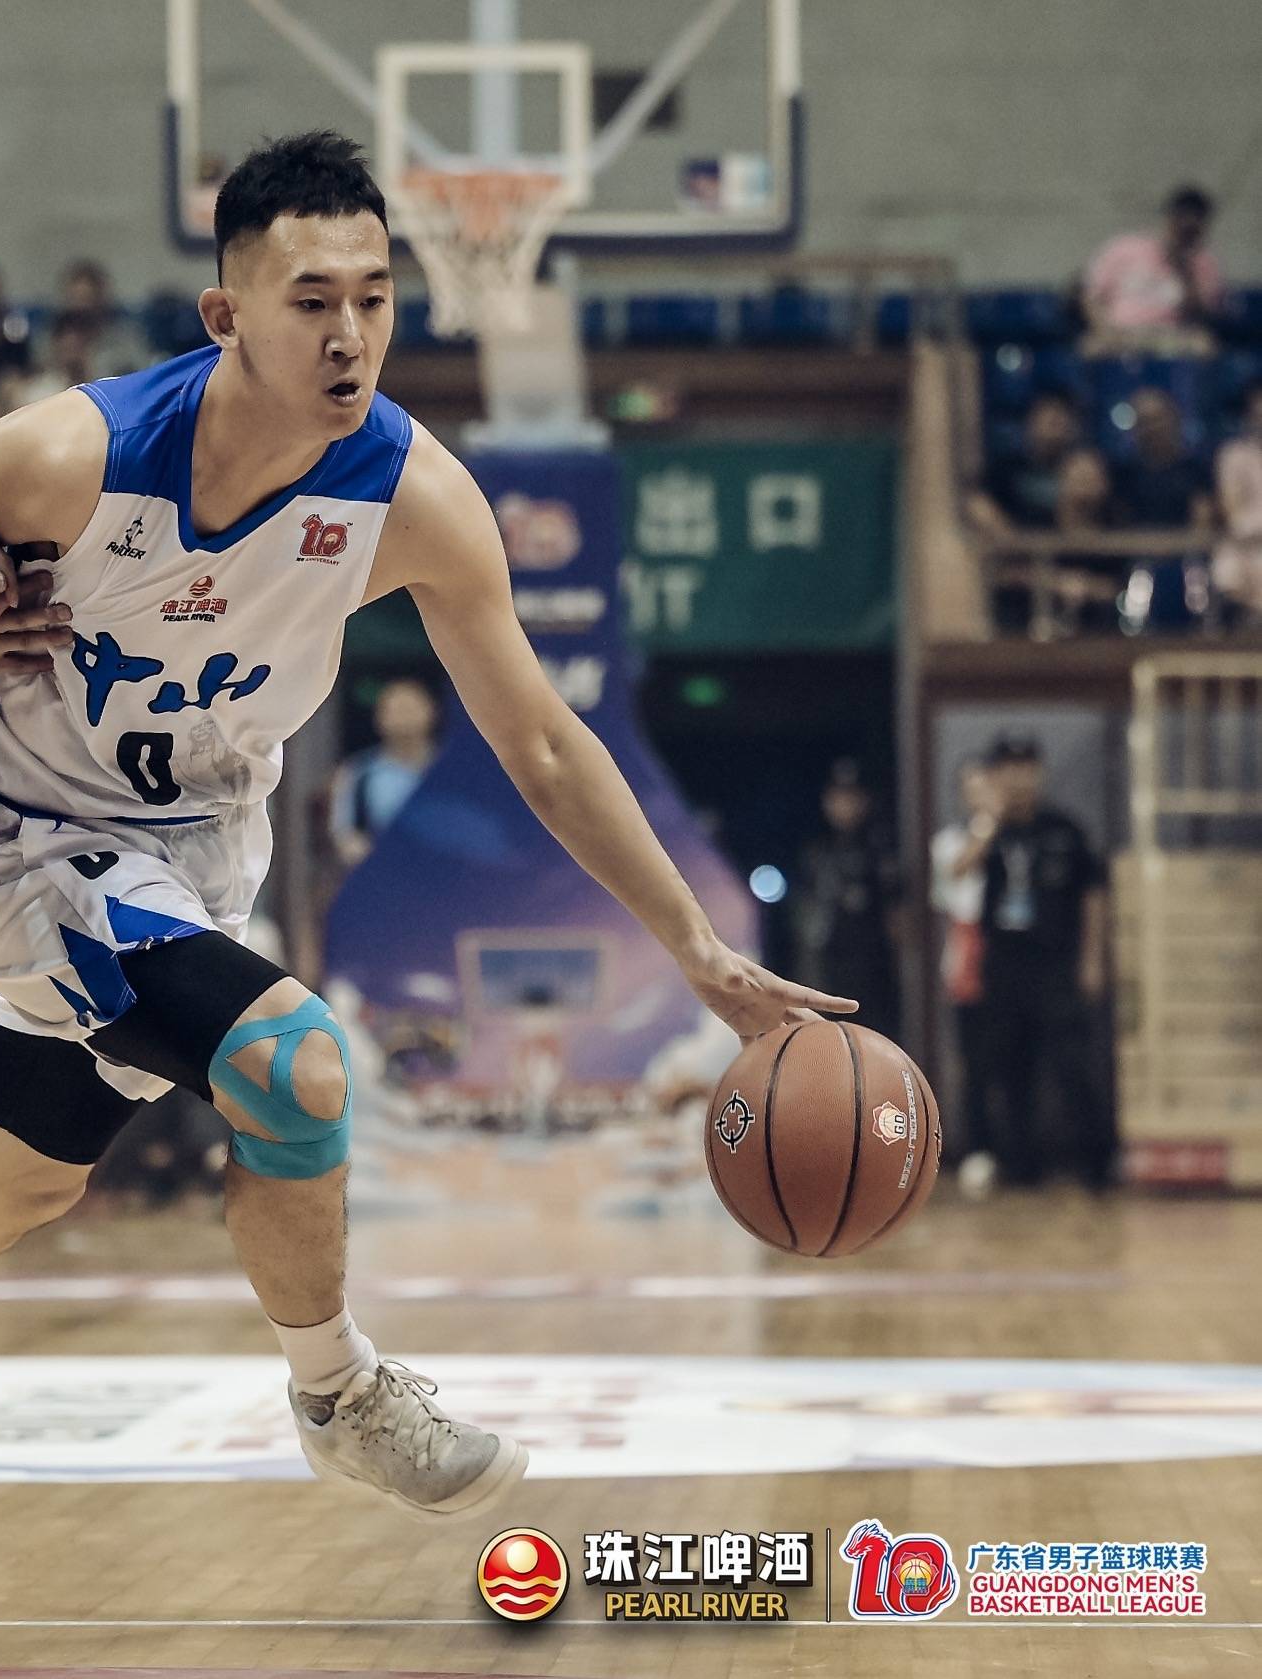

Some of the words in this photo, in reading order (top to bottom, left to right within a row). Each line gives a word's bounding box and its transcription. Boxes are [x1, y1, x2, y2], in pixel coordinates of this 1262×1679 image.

[635, 465, 822, 558] 出口
[160, 598, 228, 615] 珠江啤酒
[162, 614, 190, 622] PEARL
[190, 613, 216, 623] RIVER
[116, 731, 182, 806] 0
[894, 1114, 905, 1135] GD
